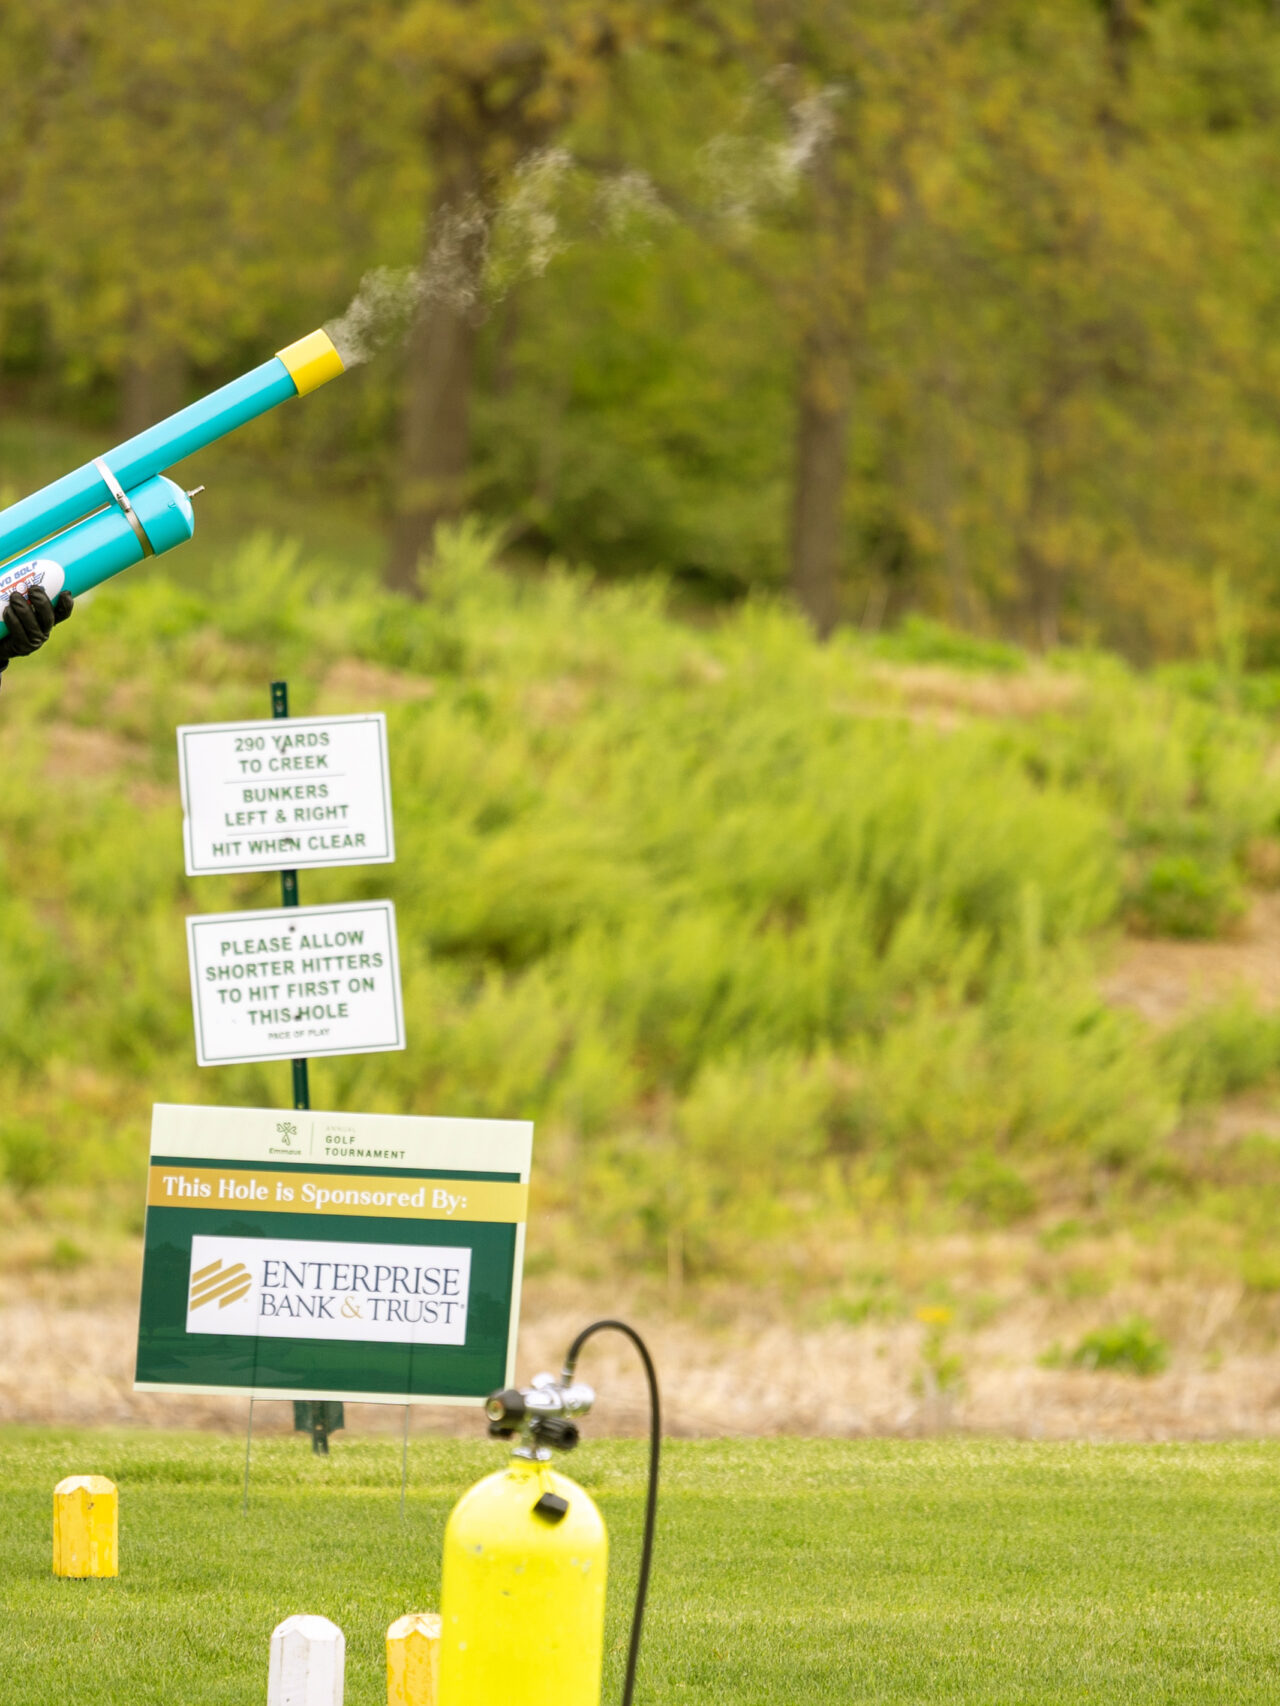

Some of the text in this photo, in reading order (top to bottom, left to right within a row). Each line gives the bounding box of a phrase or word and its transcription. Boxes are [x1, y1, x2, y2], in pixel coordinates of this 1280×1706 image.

[234, 732, 330, 752] 290 YARDS
[239, 754, 328, 774] TO CREEK
[243, 784, 329, 803] BUNKERS
[225, 805, 349, 827] LEFT & RIGHT
[212, 833, 367, 857] HIT WHEN CLEAR
[220, 930, 364, 957] PLEASE ALLOW
[206, 953, 383, 982] SHORTER HITTERS
[217, 977, 375, 1004] TO HIT FIRST ON
[248, 1003, 349, 1025] THIS HOLE
[293, 1030, 305, 1038] OF
[308, 1027, 330, 1037] PLAY
[325, 1135, 356, 1145] GOLF
[325, 1147, 406, 1160] TOURNAMENT
[163, 1176, 468, 1215] This Hole is Sponsored By:
[261, 1259, 461, 1296] ENTERPRISE
[259, 1294, 461, 1325] BANK & TRUST
